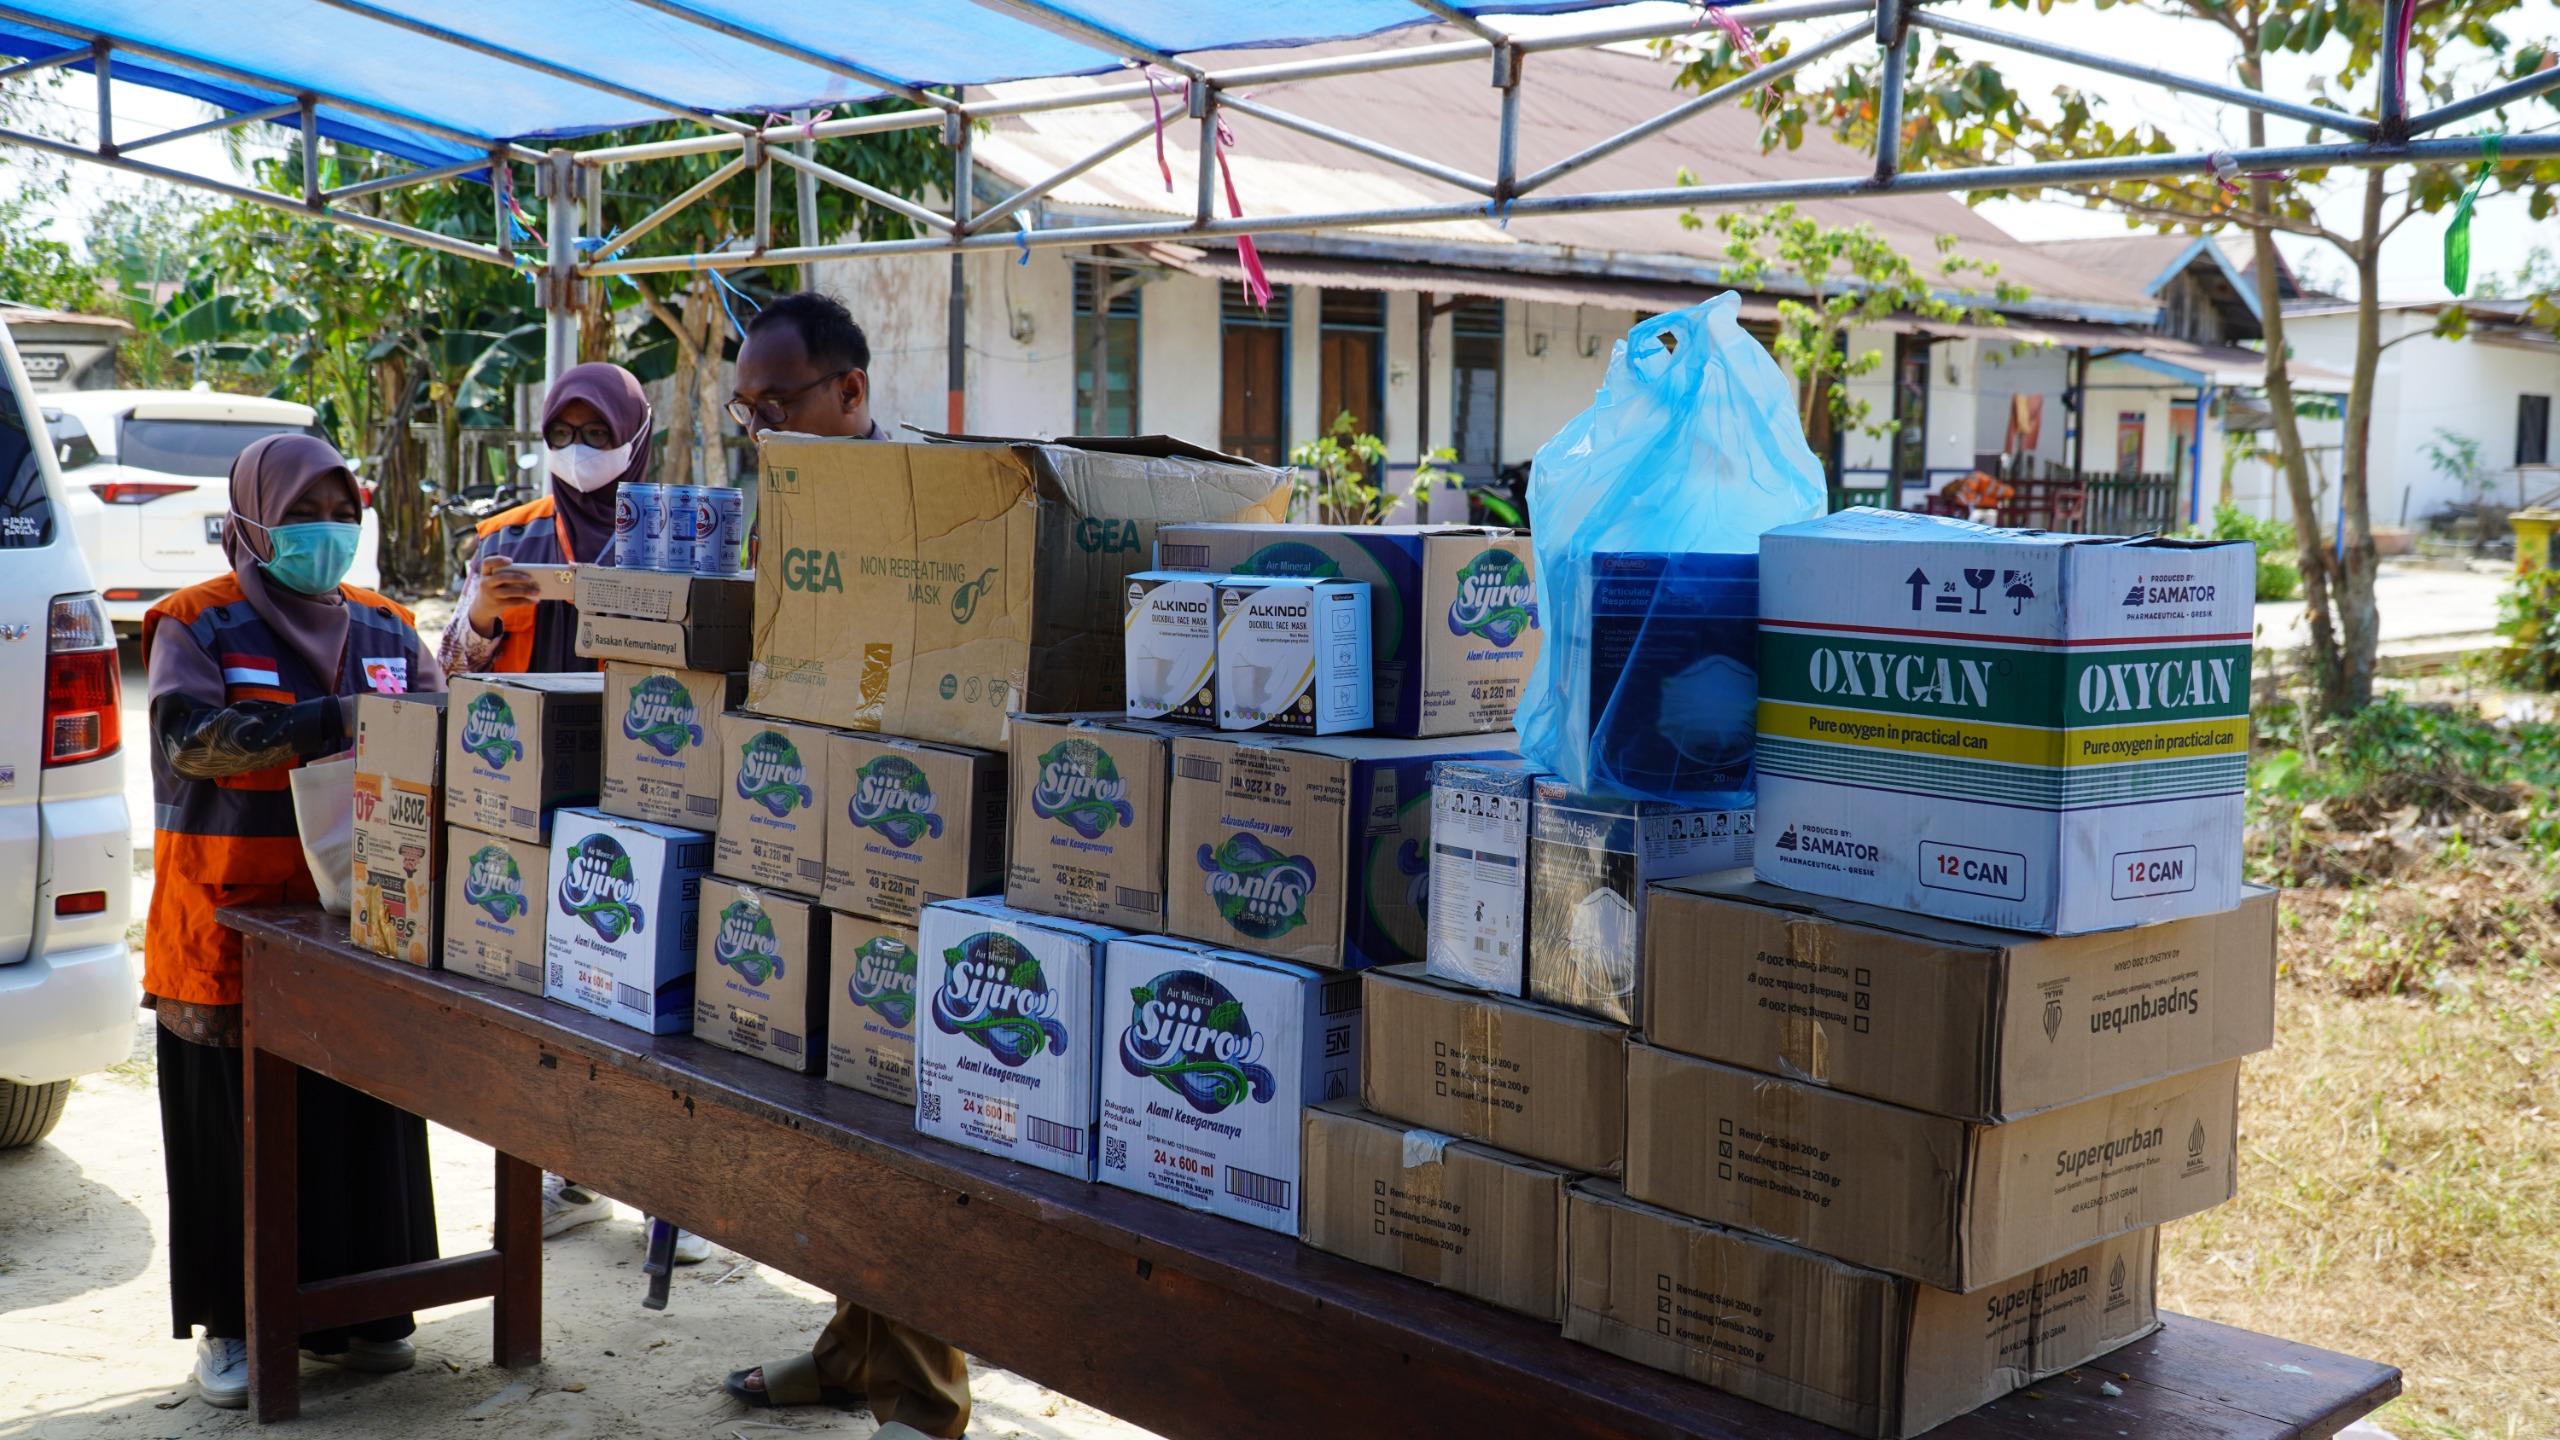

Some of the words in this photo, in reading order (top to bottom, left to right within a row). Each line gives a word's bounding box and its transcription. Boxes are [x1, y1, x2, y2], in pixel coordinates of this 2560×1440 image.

[1076, 517, 1141, 553] GEA
[784, 547, 843, 594] GEA
[861, 555, 886, 576] NON
[890, 558, 965, 583] REBREATHING
[908, 584, 941, 605] MASK
[1602, 588, 1650, 596] Particulate
[1944, 582, 1955, 592] 24
[2148, 586, 2215, 603] SAMATOR
[1152, 600, 1207, 613] ALKINDO
[1602, 597, 1649, 606] Respirator
[1152, 615, 1175, 624] DUCKBILL
[1177, 616, 1189, 624] FACE
[1192, 617, 1207, 625] MASK
[1250, 606, 1306, 617] ALKINDO
[2127, 612, 2184, 620] PHARMACEUTICAL
[1249, 621, 1273, 629] DUCKBILL
[1276, 621, 1288, 629] FACE
[1292, 622, 1307, 630] MASK
[596, 634, 622, 646] Rasakan
[624, 637, 676, 654] Kemurniannya!
[766, 654, 797, 668] MEDICAL
[1810, 648, 1992, 707] OXYCAN
[2079, 658, 2234, 713] OXYCAN
[1810, 716, 1836, 732] Pure
[1839, 723, 1884, 740] oxygen
[1888, 724, 1899, 739] in
[1902, 729, 1960, 746] practical
[1963, 735, 1987, 749] can
[2084, 740, 2110, 755] Pure
[2112, 740, 2152, 756] oxygen
[2155, 734, 2164, 749] in
[2167, 730, 2213, 752] practical
[2215, 731, 2233, 744] can
[1713, 774, 1725, 782] 20
[356, 790, 375, 822] 40
[1567, 820, 1597, 838] Mask
[1803, 825, 1838, 836] PRODUCED
[1840, 830, 1852, 838] BY:
[358, 836, 364, 854] 9
[1801, 836, 1879, 862] SAMATOR
[1780, 856, 1840, 872] PHARMACEUTICAL
[1849, 866, 1875, 876] GRESIK
[1937, 854, 1959, 875] 12
[1963, 860, 2007, 885] CAN
[2127, 862, 2145, 882] 12
[2149, 860, 2183, 882] CAN
[1757, 951, 1765, 961] gr
[1767, 955, 1784, 966] 200
[2132, 958, 2143, 967] 200
[2150, 950, 2171, 964] KALENG
[2172, 950, 2179, 958] 40
[1819, 964, 1848, 978] Kornet
[2114, 960, 2131, 971] GRAM
[1747, 972, 1756, 983] gr
[1758, 976, 1774, 987] 200
[1777, 979, 1807, 994] Domba
[1167, 987, 1179, 998] Air
[1182, 991, 1213, 1006] Mineral
[1758, 997, 1767, 1007] gr
[1810, 983, 1847, 1002] Rendang
[2044, 989, 2063, 999] HALAL
[1769, 1001, 1786, 1012] 200
[1789, 1003, 1807, 1016] Sapi
[1809, 1006, 1847, 1025] Rendang
[2091, 986, 2198, 1034] Superqurban
[1326, 1030, 1349, 1052] SNI
[957, 1056, 981, 1073] Alami
[983, 1062, 1040, 1090] Kesegarannya
[964, 1099, 974, 1112] 24
[985, 1104, 1002, 1120] 600
[1005, 1111, 1016, 1124] ml
[1146, 1101, 1174, 1119] Alami
[1175, 1108, 1242, 1139] Kesegarannya
[1104, 1121, 1118, 1131] Anda
[1125, 1116, 1141, 1127] Lokal
[1739, 1128, 1777, 1148] Rendang
[1780, 1139, 1799, 1152] Sapi
[1802, 1145, 1818, 1157] 200
[1820, 1151, 1830, 1161] gr
[2056, 1127, 2163, 1176] Superqurban
[1154, 1149, 1166, 1165] 24
[1170, 1157, 1175, 1167] x
[1179, 1156, 1198, 1173] 600
[1201, 1165, 1213, 1178] ml
[1739, 1150, 1777, 1170] Rendang
[1779, 1161, 1810, 1177] Domba
[1812, 1170, 1829, 1183] 200
[1831, 1177, 1841, 1187] gr
[2187, 1159, 2203, 1168] HALAL
[1738, 1172, 1767, 1188] Kornet
[1769, 1181, 1800, 1197] Domba
[1803, 1190, 1819, 1203] 200
[1821, 1197, 1831, 1207] gr
[1440, 1200, 1452, 1210] 200
[1453, 1205, 1461, 1213] gr
[2072, 1205, 2079, 1213] 40
[2080, 1197, 2103, 1211] KALENG
[2104, 1196, 2109, 1204] X
[2109, 1192, 2119, 1201] 200
[2120, 1186, 2137, 1198] GRAM
[1390, 1208, 1420, 1224] Rendang
[1422, 1216, 1446, 1228] Domba
[1448, 1222, 1461, 1232] 200
[1463, 1227, 1471, 1236] gr
[1390, 1227, 1413, 1240] Kornet
[1415, 1234, 1439, 1247] Domba
[1441, 1241, 1453, 1251] 200
[1455, 1245, 1463, 1254] gr
[1677, 1284, 1714, 1304] Rendang
[1716, 1294, 1734, 1308] Sapi
[1736, 1300, 1751, 1312] 200
[1753, 1307, 1762, 1317] gr
[1987, 1266, 2088, 1322] Superqurban
[1677, 1305, 1714, 1326] Rendang
[1716, 1317, 1745, 1333] Domba
[1747, 1326, 1763, 1338] 200
[1765, 1332, 1775, 1343] gr
[2050, 1325, 2066, 1338] GRAM
[1676, 1327, 1704, 1343] Kornet
[1707, 1336, 1736, 1353] Domba
[1738, 1345, 1754, 1358] 200
[1756, 1353, 1765, 1363] gr
